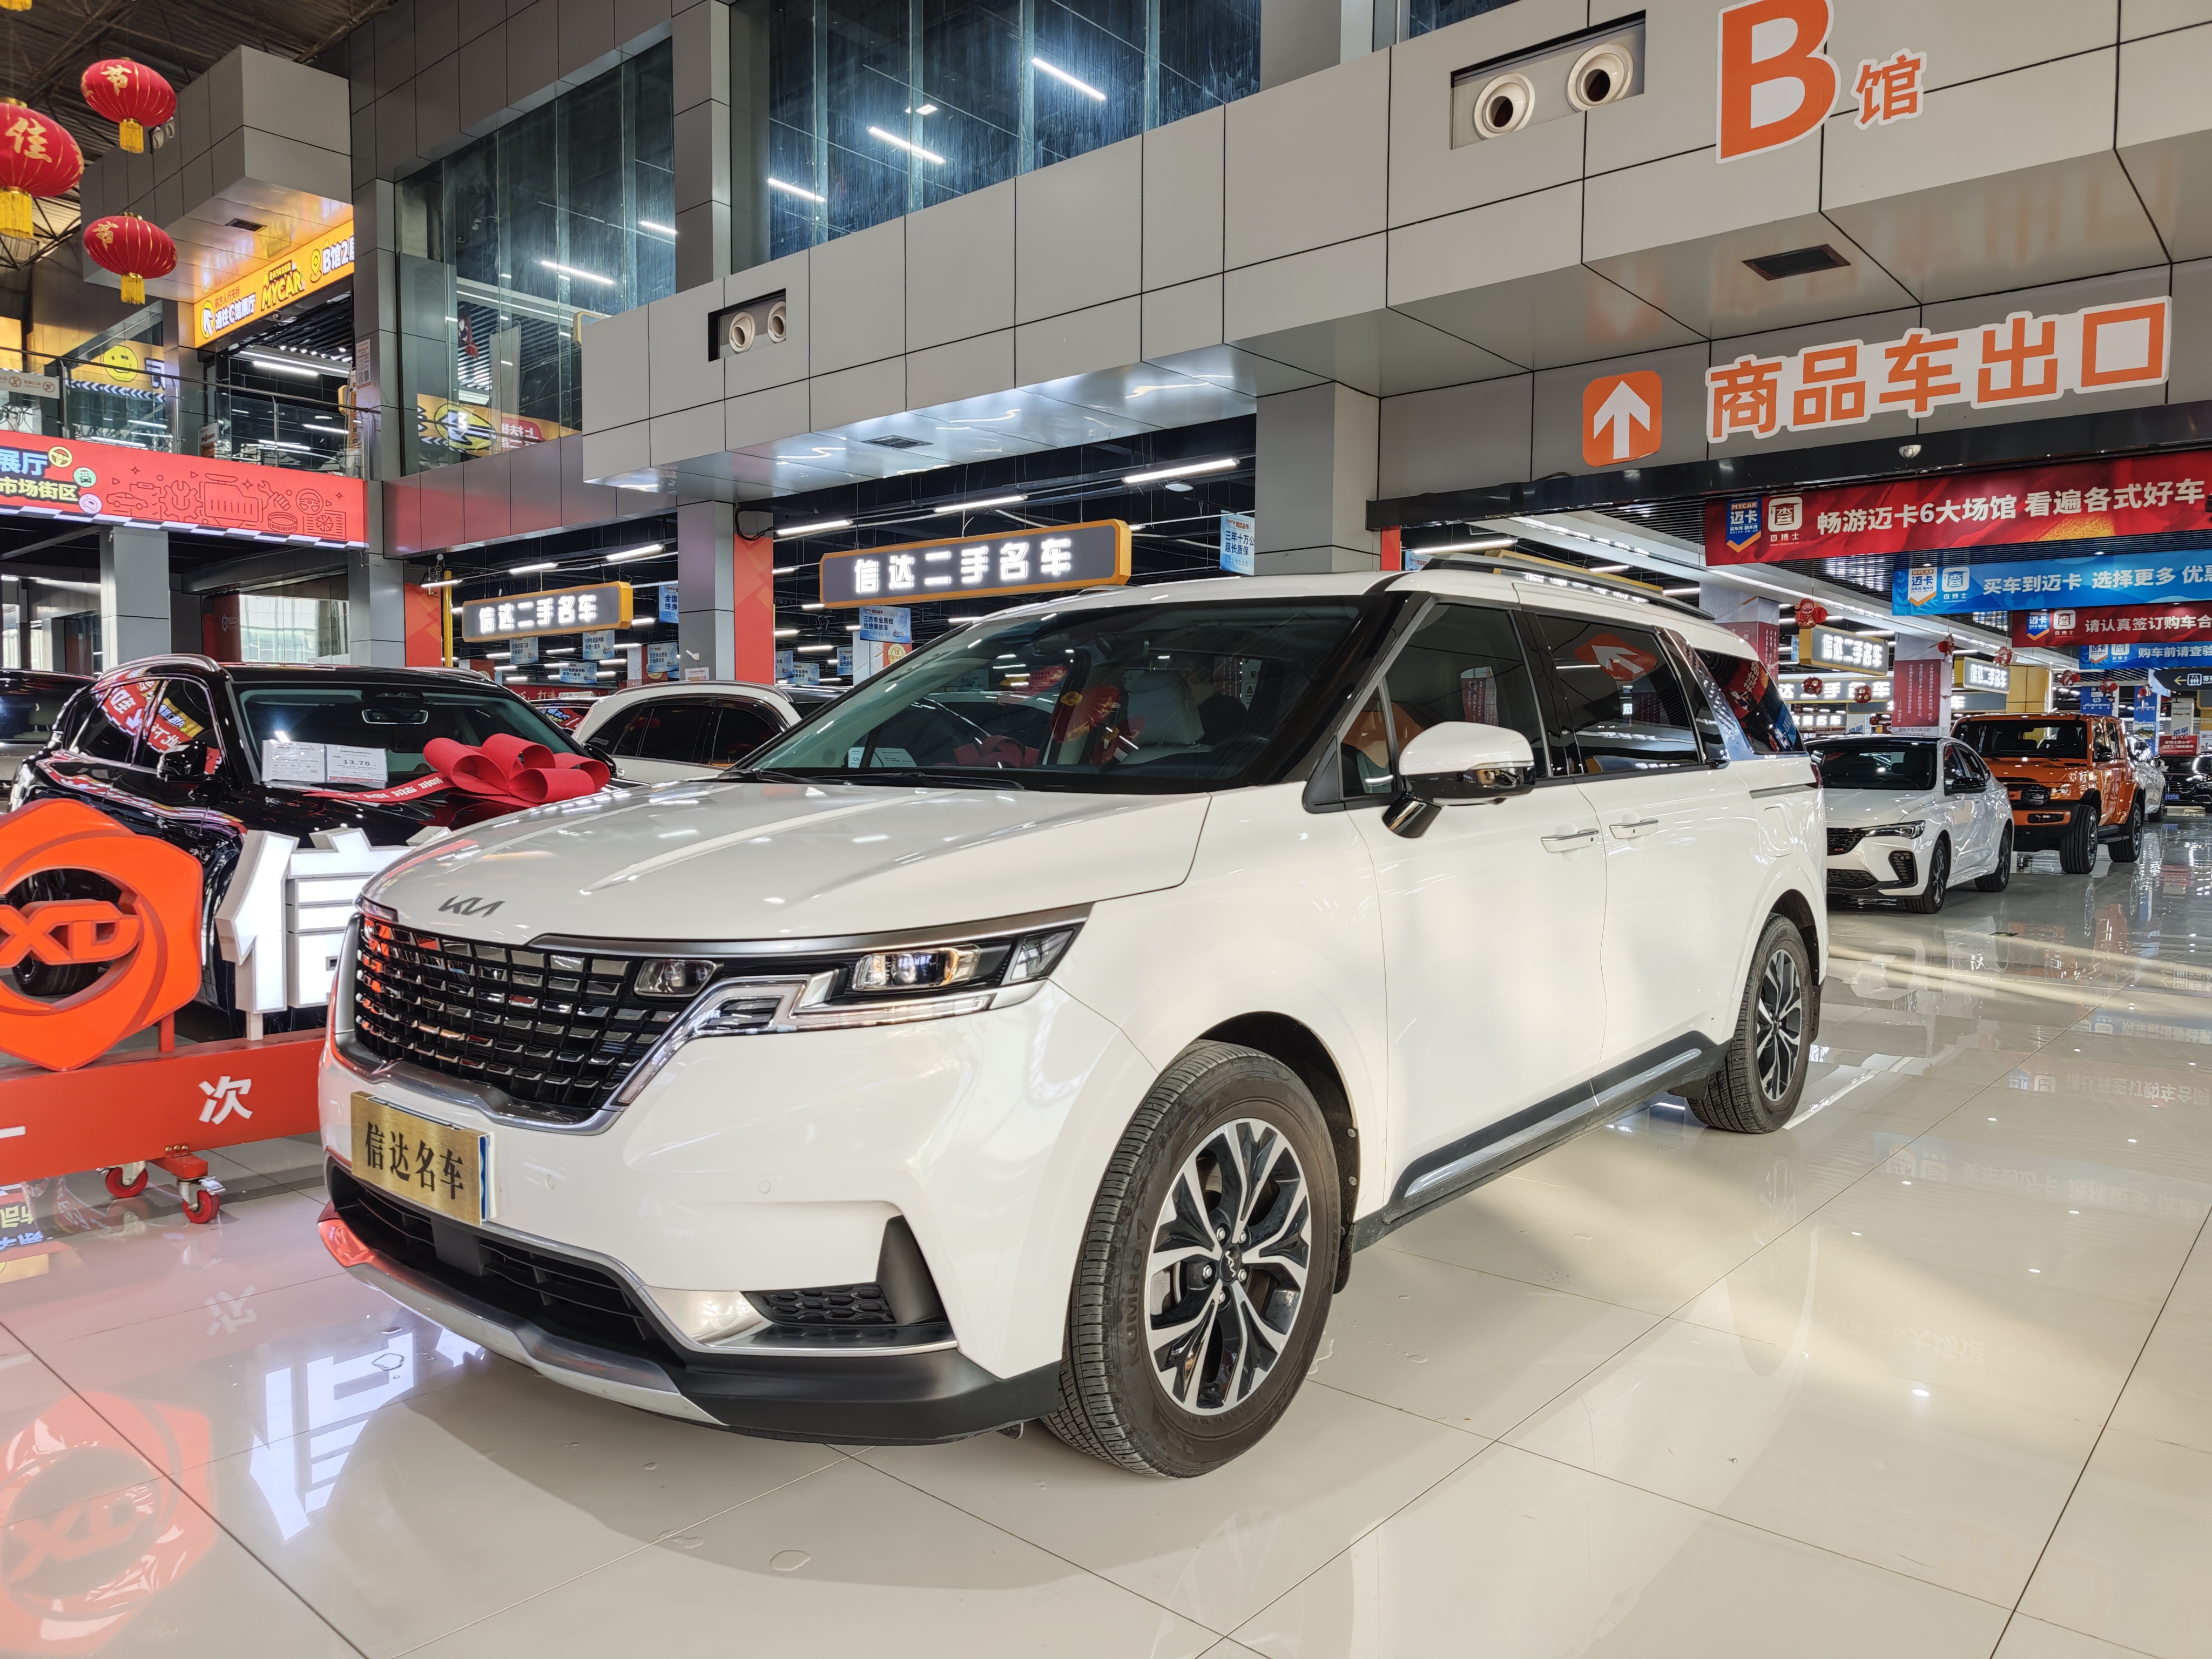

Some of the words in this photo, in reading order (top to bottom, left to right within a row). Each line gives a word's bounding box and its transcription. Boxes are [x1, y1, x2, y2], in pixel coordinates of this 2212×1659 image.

[5, 117, 52, 163] 佳
[214, 286, 240, 308] 前方人行天桥
[261, 271, 305, 311] MYCAR
[214, 292, 256, 332] 通往C馆展厅
[1708, 300, 2169, 440] 商品车出口
[0, 448, 48, 476] 展厅
[0, 476, 78, 502] 市场街区
[1730, 510, 1758, 525] 迈卡
[1817, 494, 2017, 535] 畅游迈卡6大场馆
[2024, 478, 2205, 518] 看遍各式好车
[1225, 530, 1255, 546] 三年十万公
[1225, 542, 1249, 556] 超长质保
[1770, 532, 1800, 542] 查博士
[854, 538, 1073, 595] 信达二手名车
[1912, 575, 1934, 586] 迈卡
[1983, 572, 2082, 596] 买车到迈卡
[2092, 568, 2175, 590] 选择更多
[664, 595, 678, 603] 全国
[664, 603, 678, 611] 终身
[478, 594, 597, 635] 信达二手名车
[864, 615, 894, 625] 三方专业质检
[864, 623, 889, 631] 杜绝事故车
[2029, 616, 2048, 625] 迈卡
[2085, 615, 2212, 633] 请认真签订购车合
[1823, 633, 1883, 667] 信达二手名车
[2138, 645, 2212, 659] 购车前请查验
[439, 894, 506, 918] KIA
[199, 1075, 254, 1125] 次
[365, 1120, 465, 1201] 信达名车
[1125, 1247, 1143, 1366] KUMHO
